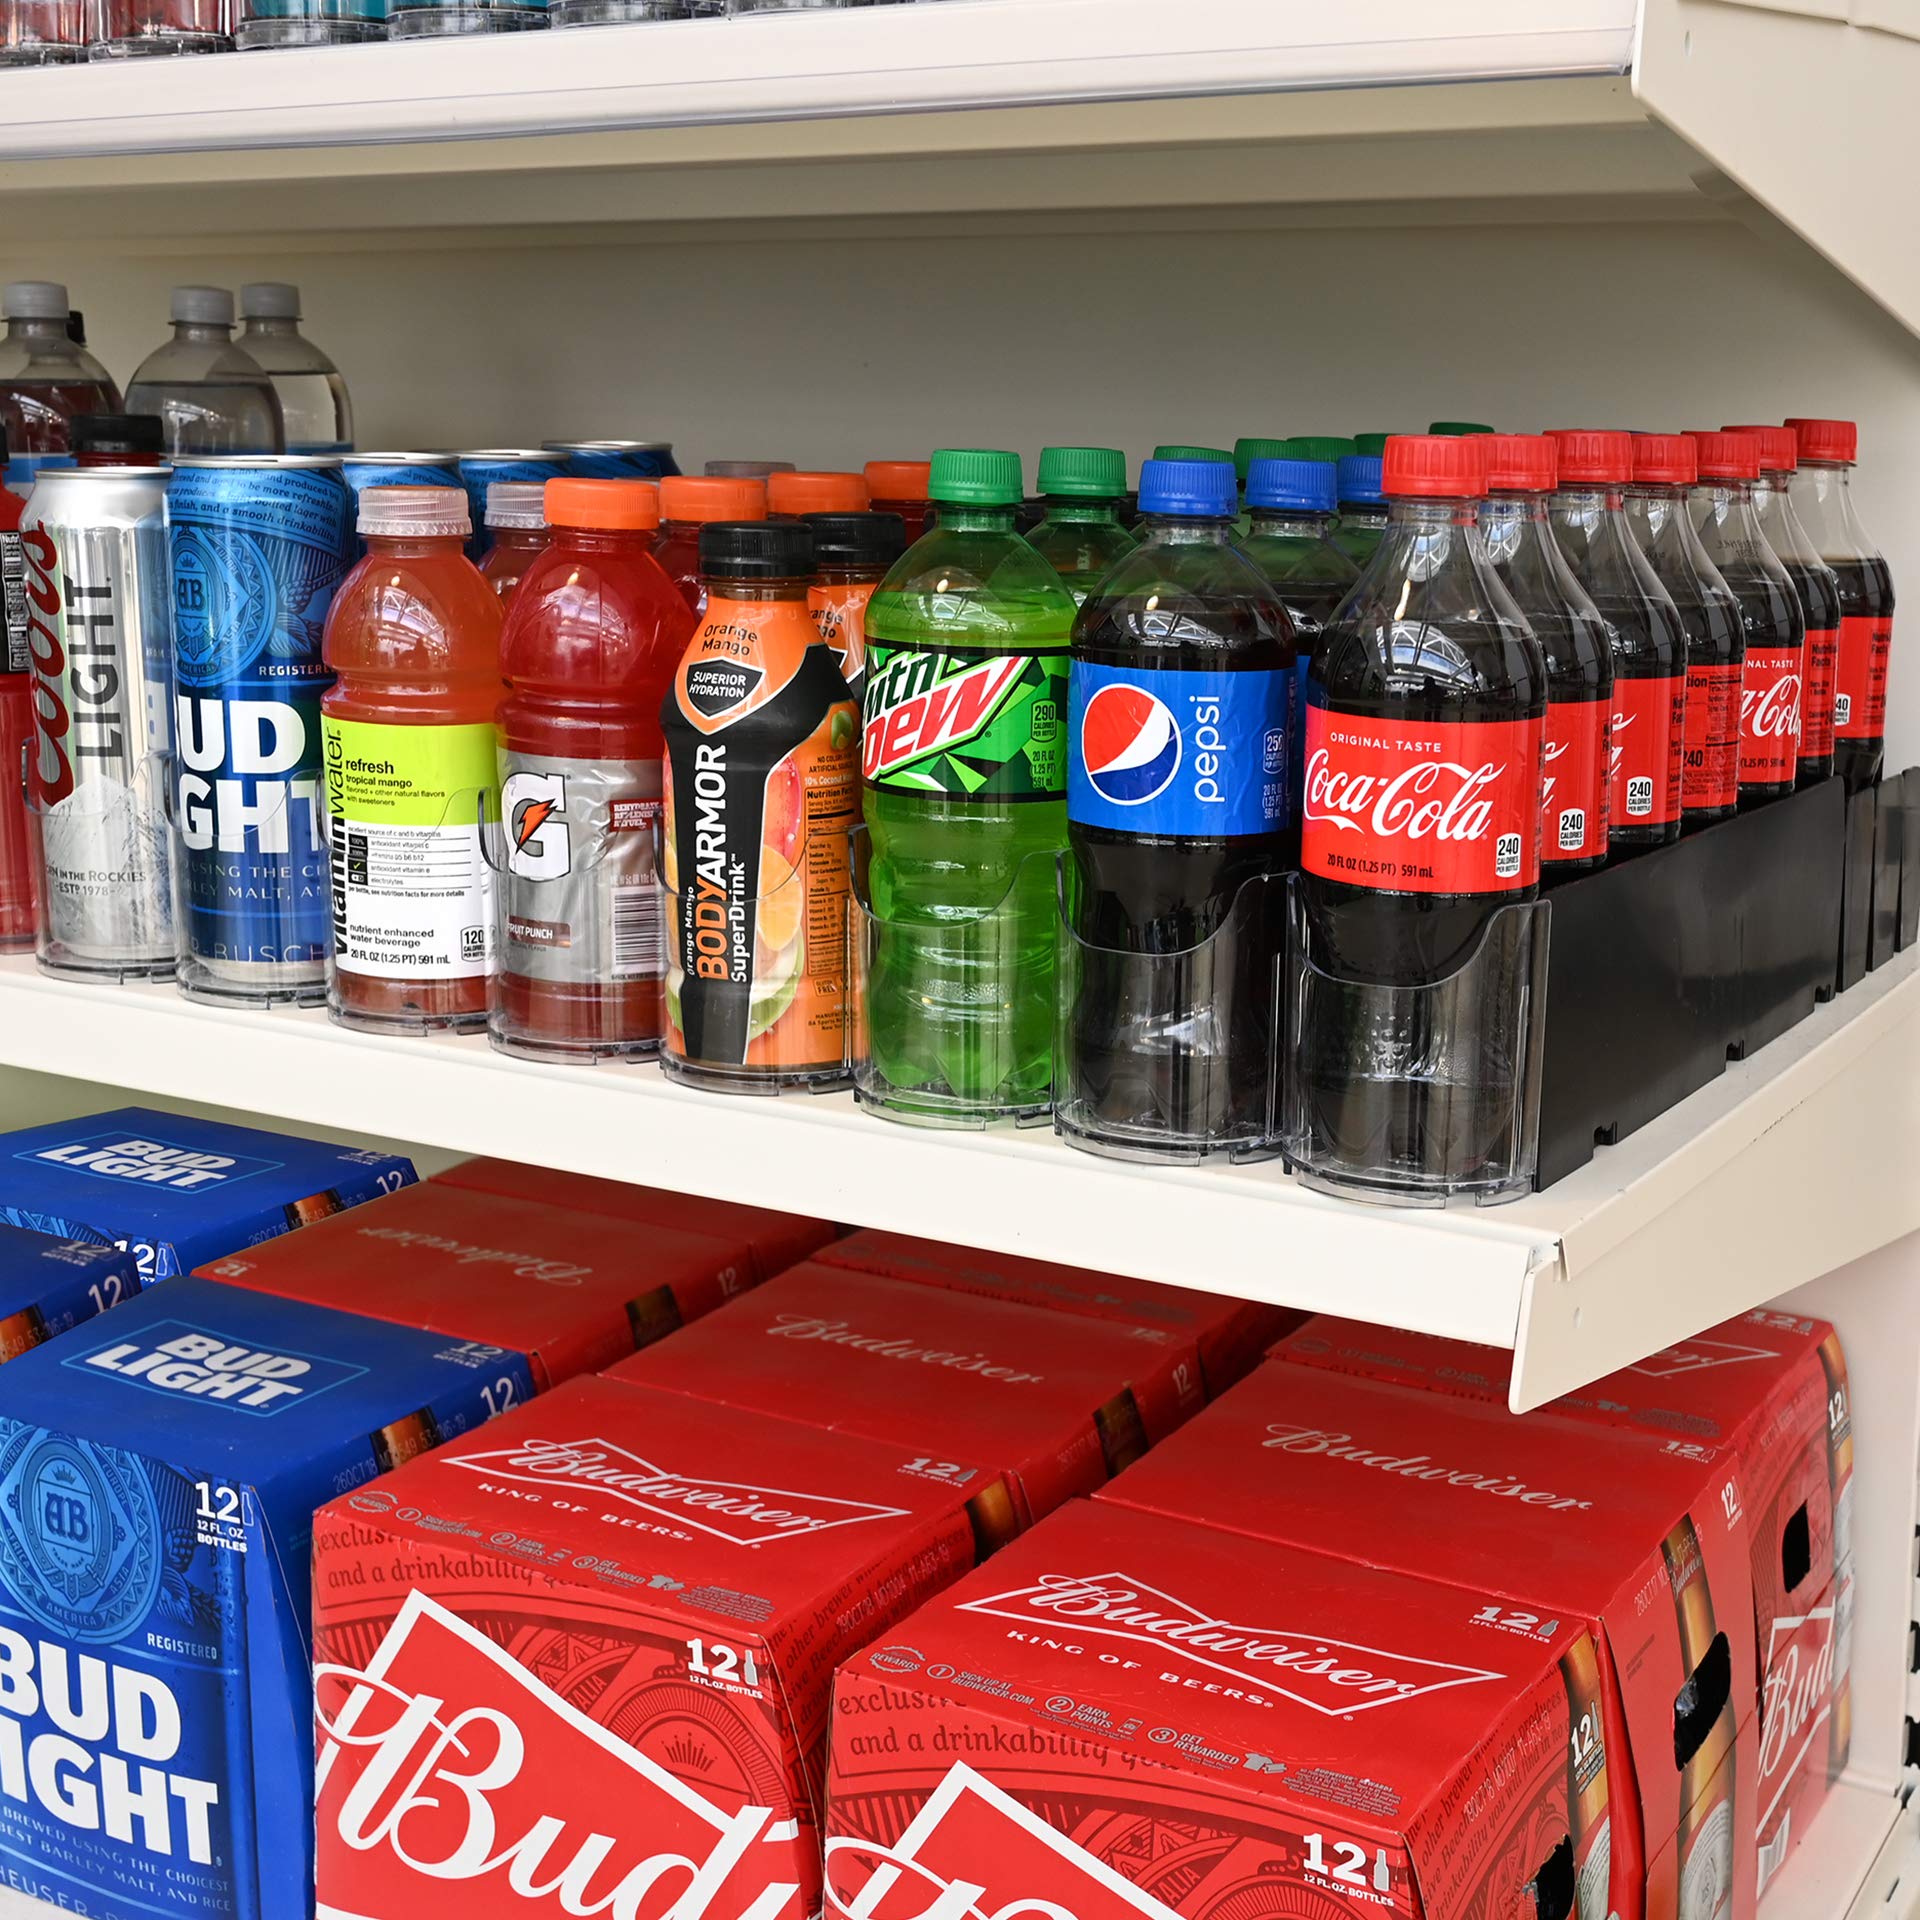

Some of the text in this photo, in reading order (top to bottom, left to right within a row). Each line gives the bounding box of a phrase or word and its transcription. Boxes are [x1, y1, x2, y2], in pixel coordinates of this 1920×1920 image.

[262, 486, 290, 498] more
[201, 502, 275, 523] and smooth
[704, 624, 758, 643] Orange
[701, 638, 750, 656] Mango
[20, 520, 75, 807] Coors
[63, 574, 124, 758] LIGHT
[1771, 660, 1794, 669] TASTE
[688, 683, 745, 698] HYDRATION
[692, 670, 747, 686] SUPERIOR
[1034, 705, 1055, 722] 290
[178, 695, 306, 774] UD
[1330, 731, 1442, 753] ORIGINAL TASTE
[1032, 750, 1041, 762] 20
[1188, 694, 1227, 803] pepsi
[345, 758, 395, 775] refresh
[345, 774, 412, 790] tropical mango
[394, 790, 420, 798] natural
[420, 790, 446, 798] flavors
[807, 788, 840, 799] Nutrition
[1303, 748, 1509, 841] Coca-Cola
[1629, 781, 1651, 798] 240
[178, 772, 321, 855] GHT
[1628, 798, 1651, 806] CALORIES
[501, 772, 572, 883] G
[1561, 813, 1584, 831] 240
[1498, 837, 1520, 857] 240
[1560, 831, 1584, 840] CALORIES
[248, 866, 293, 878] THE
[694, 743, 729, 981] BODYARMOR
[1327, 853, 1435, 879] 20 FL OZ (1.25 PT) 591 mL
[1496, 856, 1519, 866] CALORIES
[69, 870, 147, 882] THE ROCKIES
[228, 886, 291, 901] MALT,
[405, 890, 420, 898] facts
[446, 890, 465, 898] details
[350, 934, 422, 948] water beverage
[384, 927, 435, 938] enhanced
[464, 930, 485, 945] 120
[525, 926, 553, 940] PUNCH
[360, 949, 435, 965] FL OZ PT) 591
[684, 931, 695, 976] Orange
[35, 1144, 229, 1188] LIGHT
[104, 1139, 237, 1171] BUD
[376, 1170, 403, 1195] 12
[717, 1266, 739, 1297] 12
[88, 1274, 123, 1316] 12
[1750, 1310, 1798, 1325] 12
[154, 1333, 312, 1379] BUD
[765, 1312, 1045, 1386] Budweiser
[84, 1343, 304, 1408] LIGHT
[1172, 1364, 1192, 1396] 12
[480, 1376, 519, 1420] 12
[1828, 1390, 1845, 1429] 12
[1665, 1440, 1705, 1457] 12
[901, 1457, 962, 1478] 12
[1261, 1422, 1594, 1512] Budweiser
[101, 1462, 129, 1508] EUROPE
[507, 1438, 828, 1530] Budweiser
[194, 1480, 242, 1525] 12
[478, 1482, 689, 1541] KING OF BEERS
[1721, 1480, 1738, 1520] 12
[196, 1519, 210, 1532] 12
[228, 1526, 248, 1541] OZ.
[196, 1532, 248, 1553] BOTTLES
[4, 1526, 32, 1571] AFRICA
[328, 1558, 386, 1590] and a
[592, 1565, 647, 1585] REWARDED
[599, 1559, 619, 1571] GET
[109, 1566, 130, 1596] ASIA
[45, 1602, 97, 1627] AMERICA
[1472, 1605, 1540, 1632] 12
[146, 1632, 218, 1660] REGISTERED
[1028, 1573, 1417, 1696] Budweiser
[1509, 1627, 1551, 1643] BOTTLES
[686, 1637, 742, 1682] 12
[786, 1627, 816, 1670] other
[870, 1651, 922, 1672] REWARDS
[958, 1670, 1015, 1690] SIGN UP AT
[1006, 1629, 1266, 1706] KING OF BEERS
[0, 1623, 182, 1762] BUD
[689, 1673, 764, 1700] 12 BOTTLES
[950, 1676, 1037, 1706] BUDWEISER.COM
[1070, 1709, 1115, 1730] POINTS
[1075, 1702, 1112, 1719] EARN
[850, 1724, 899, 1757] and
[907, 1731, 925, 1751] a
[1179, 1732, 1206, 1746] GET
[1571, 1713, 1594, 1768] 12
[1173, 1740, 1241, 1766] REWARDED
[0, 1713, 219, 1866] IGHT
[1441, 1764, 1475, 1818] brewer
[3, 1805, 229, 1892] BREWED USING THE CHOICEST
[1420, 1819, 1446, 1868] other
[1302, 1831, 1367, 1886] 12
[40, 1840, 105, 1875] BARLEY
[166, 1886, 198, 1905] AND
[202, 1896, 231, 1911] RICE
[1302, 1873, 1395, 1908] 12 BOTTLES
